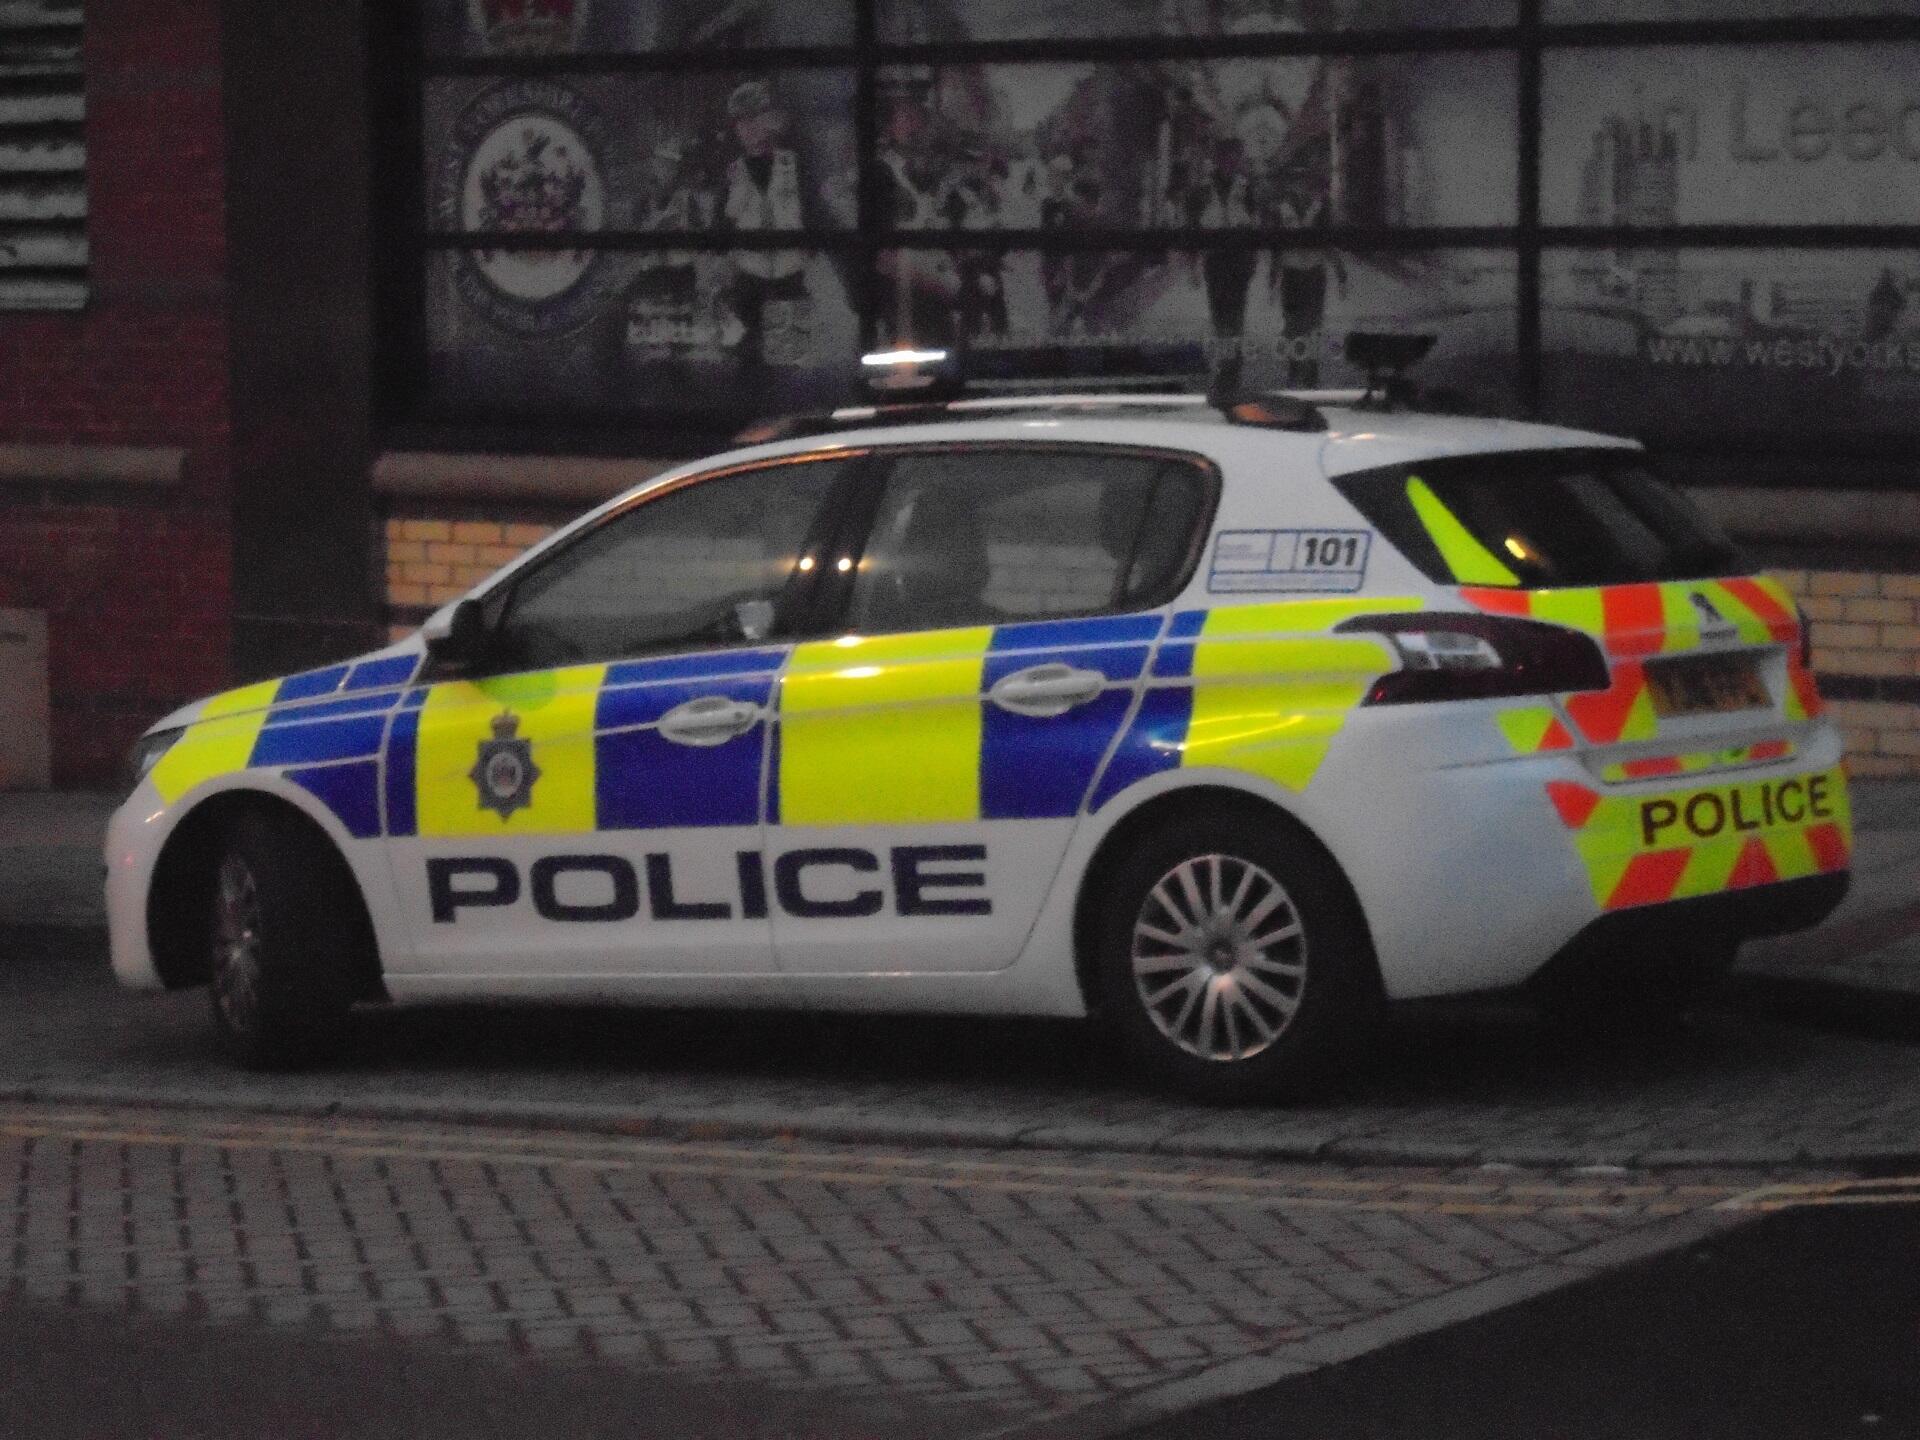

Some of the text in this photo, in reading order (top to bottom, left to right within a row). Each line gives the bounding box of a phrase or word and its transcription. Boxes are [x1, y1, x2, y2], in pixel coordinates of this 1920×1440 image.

[1304, 537, 1358, 567] 101
[1640, 773, 1834, 846] POLICE
[425, 844, 993, 924] POLICE
